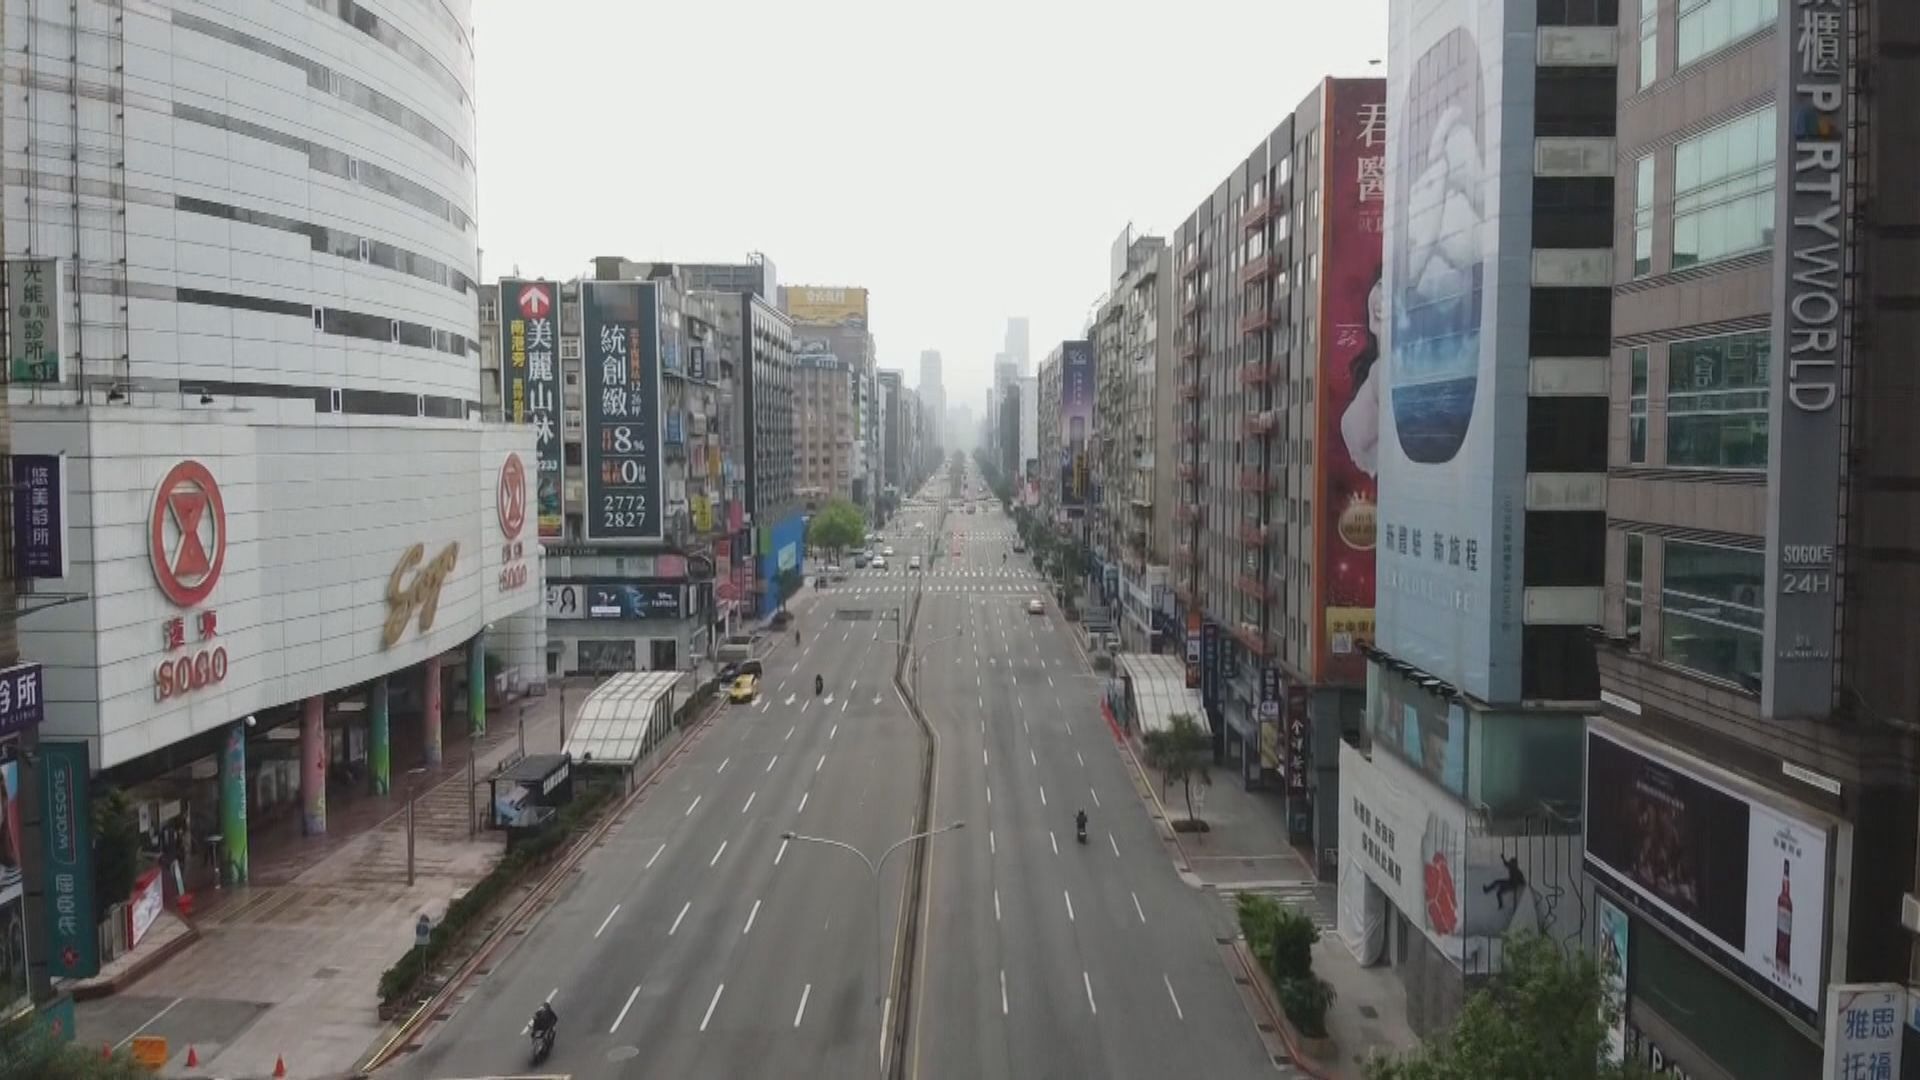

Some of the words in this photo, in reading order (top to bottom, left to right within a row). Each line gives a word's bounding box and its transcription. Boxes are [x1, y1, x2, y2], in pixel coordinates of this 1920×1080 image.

[1798, 0, 1841, 74] 櫃
[600, 324, 627, 417] 統創緻
[537, 459, 558, 472] 233
[604, 495, 646, 512] 2772
[604, 512, 646, 528] 2827
[1782, 573, 1829, 593] 24H
[155, 646, 228, 703] SOGO
[53, 769, 66, 850] watsons
[55, 873, 76, 936] 屈臣氏
[1845, 1008, 1895, 1040] 雅思
[1841, 1052, 1892, 1080] 托福
